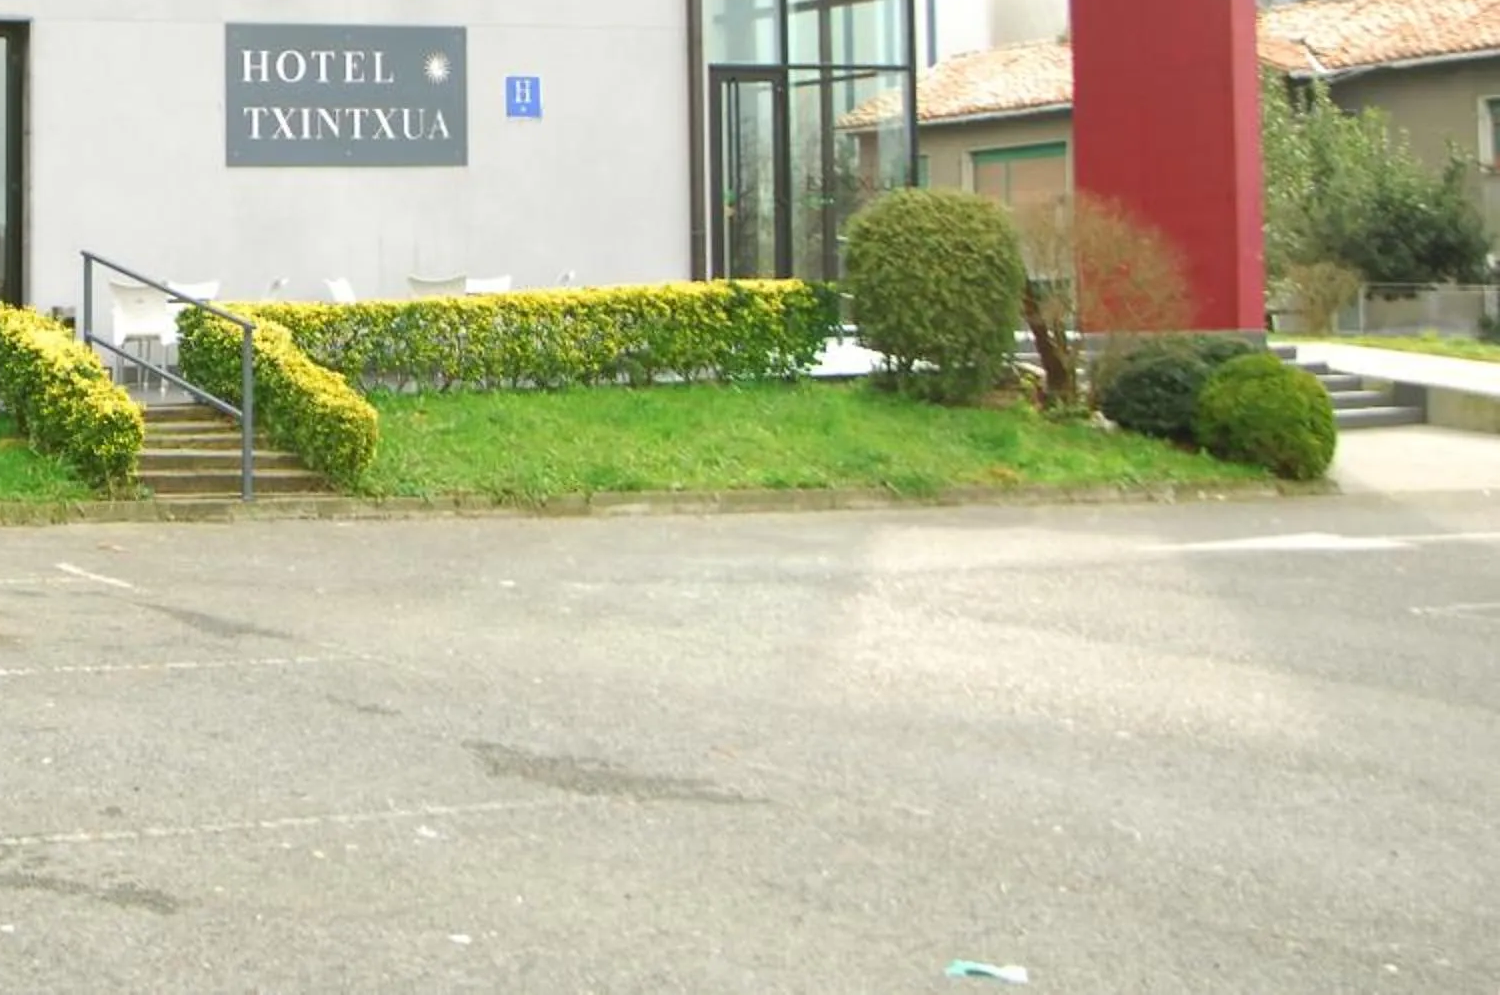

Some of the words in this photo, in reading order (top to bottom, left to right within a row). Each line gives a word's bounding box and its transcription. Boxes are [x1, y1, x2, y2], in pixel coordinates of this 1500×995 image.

[242, 49, 395, 84] HOTEL
[514, 79, 533, 104] H
[243, 107, 452, 141] TXINTXUA
